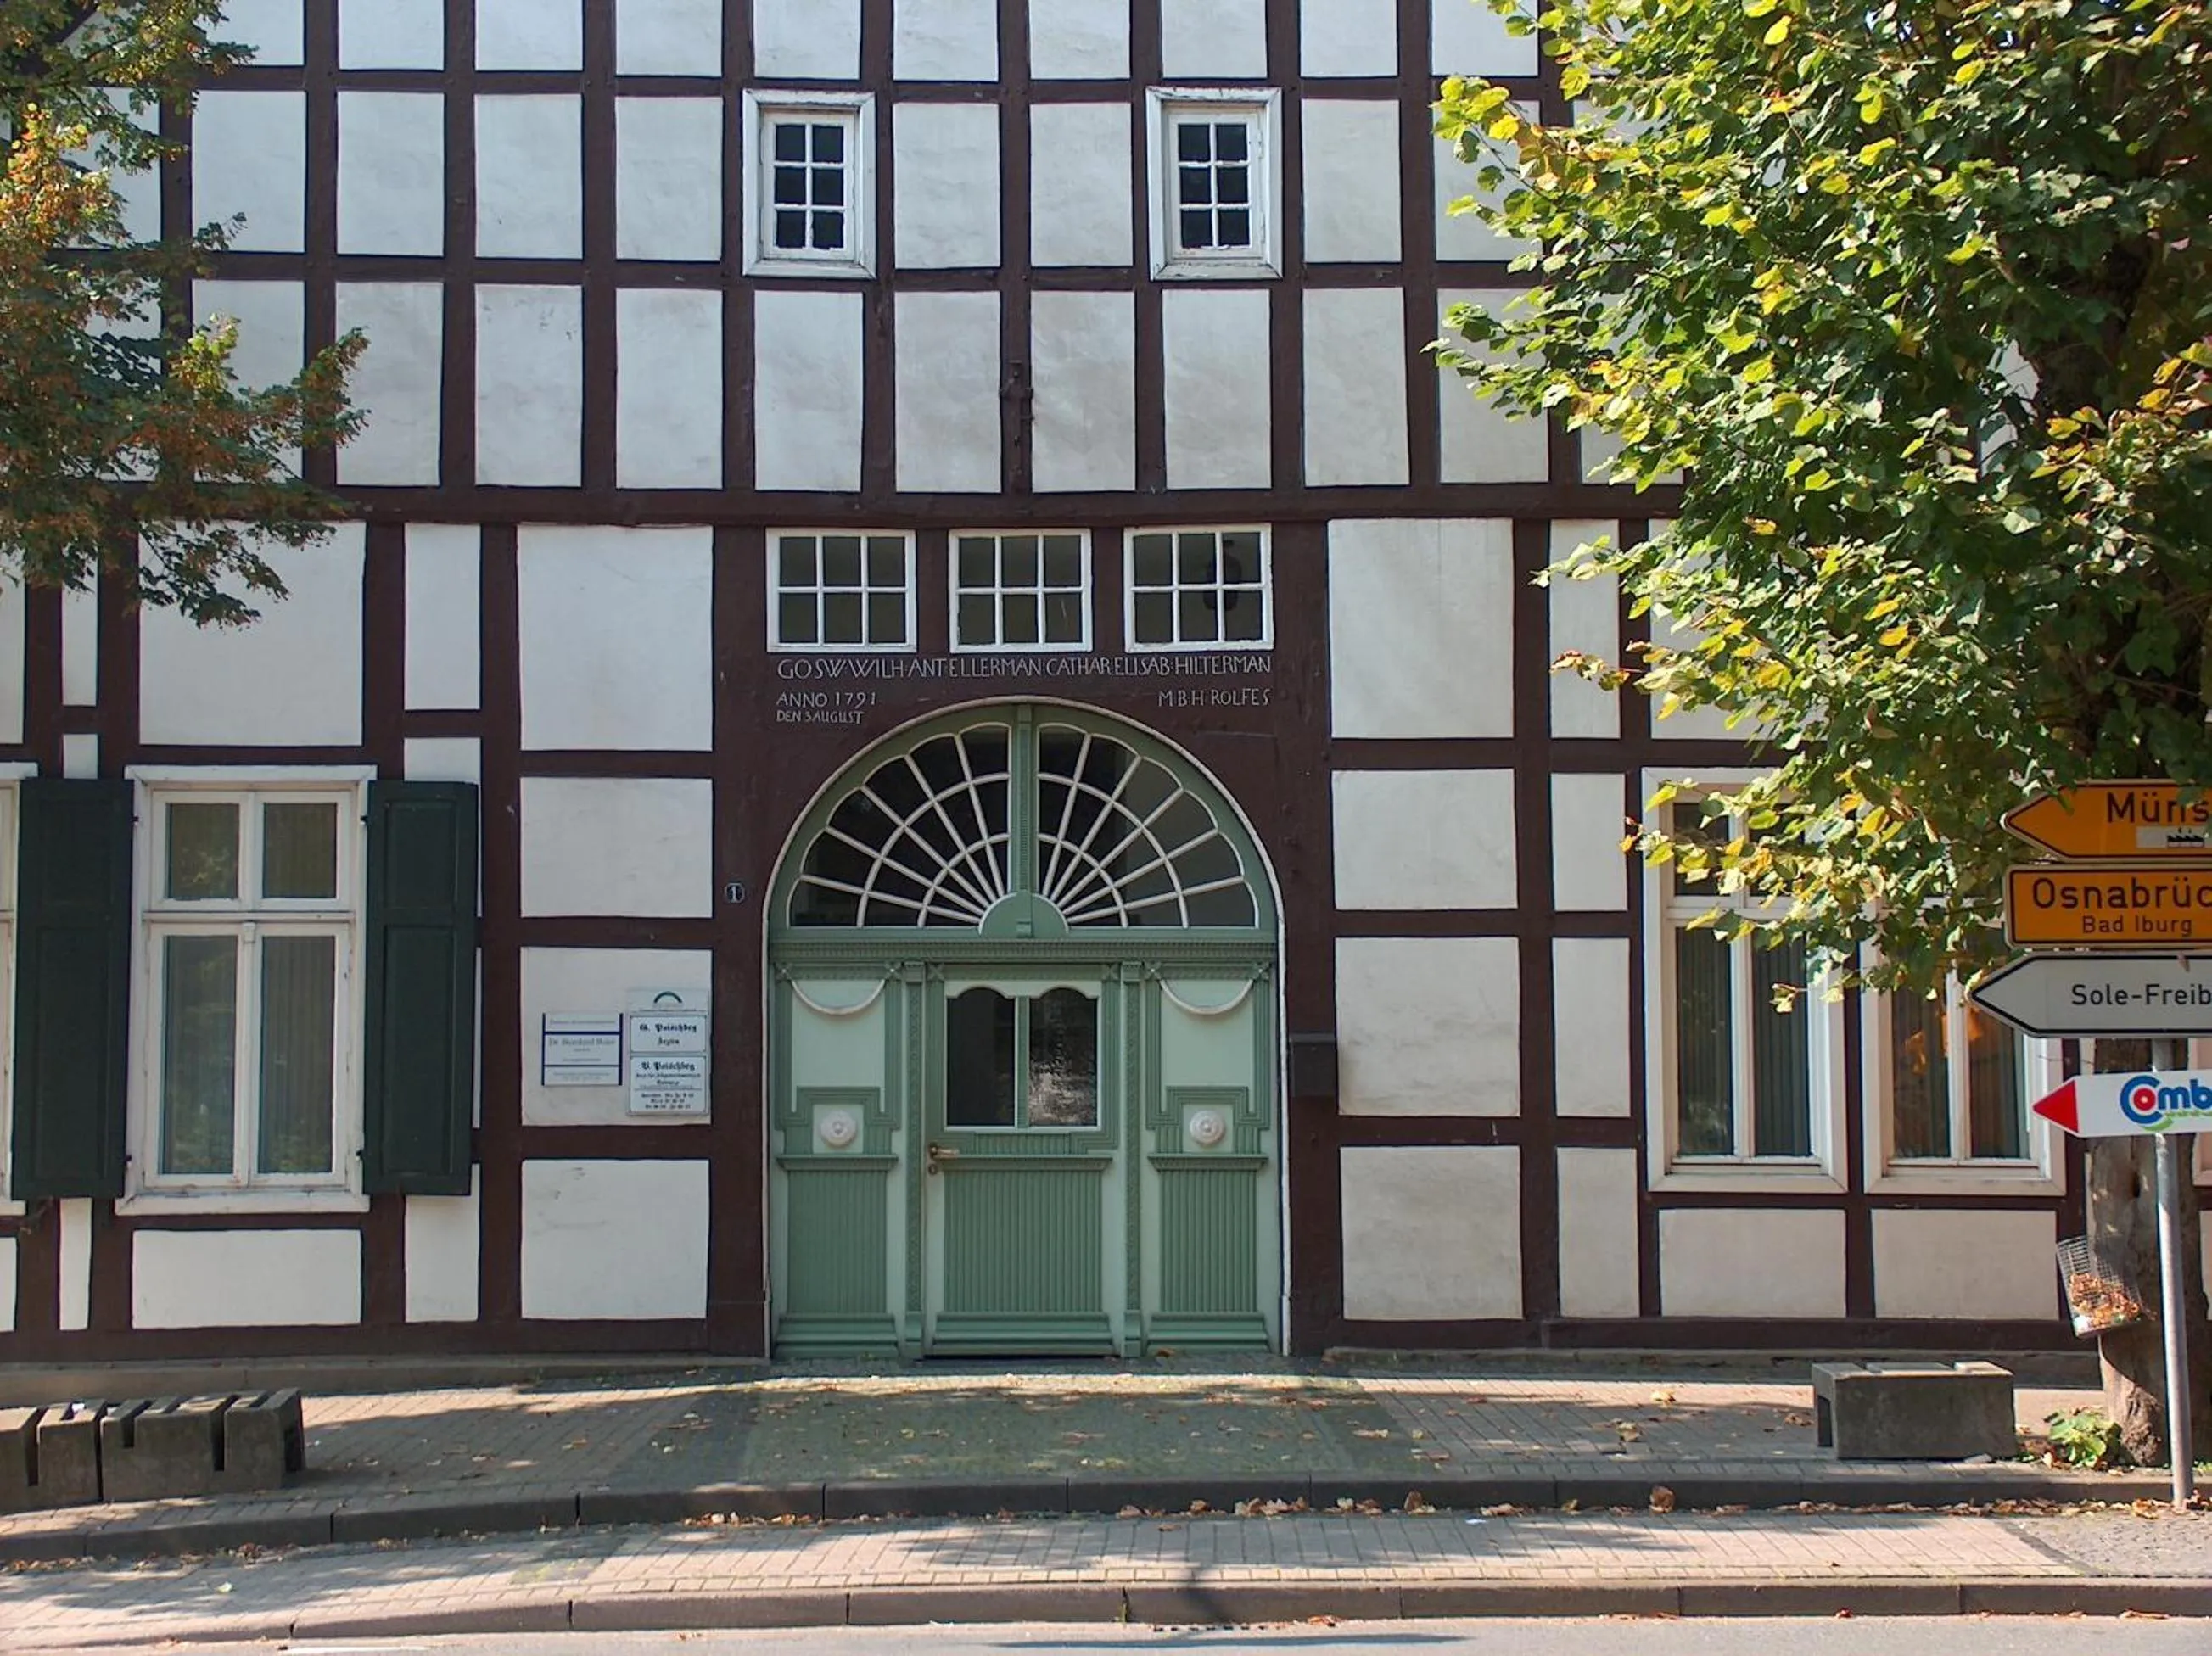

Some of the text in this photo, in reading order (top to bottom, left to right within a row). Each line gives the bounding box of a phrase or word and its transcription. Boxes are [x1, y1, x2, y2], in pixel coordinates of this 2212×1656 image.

[1174, 655, 1272, 675] HILTERMAN
[776, 691, 876, 710] ANNO 1791
[1210, 688, 1271, 707] ROLFES
[776, 709, 802, 723] DEN
[2032, 876, 2212, 909] Osnabrüc
[2082, 915, 2193, 938] Bad Iburg
[2071, 982, 2212, 1006] Sole-Freib
